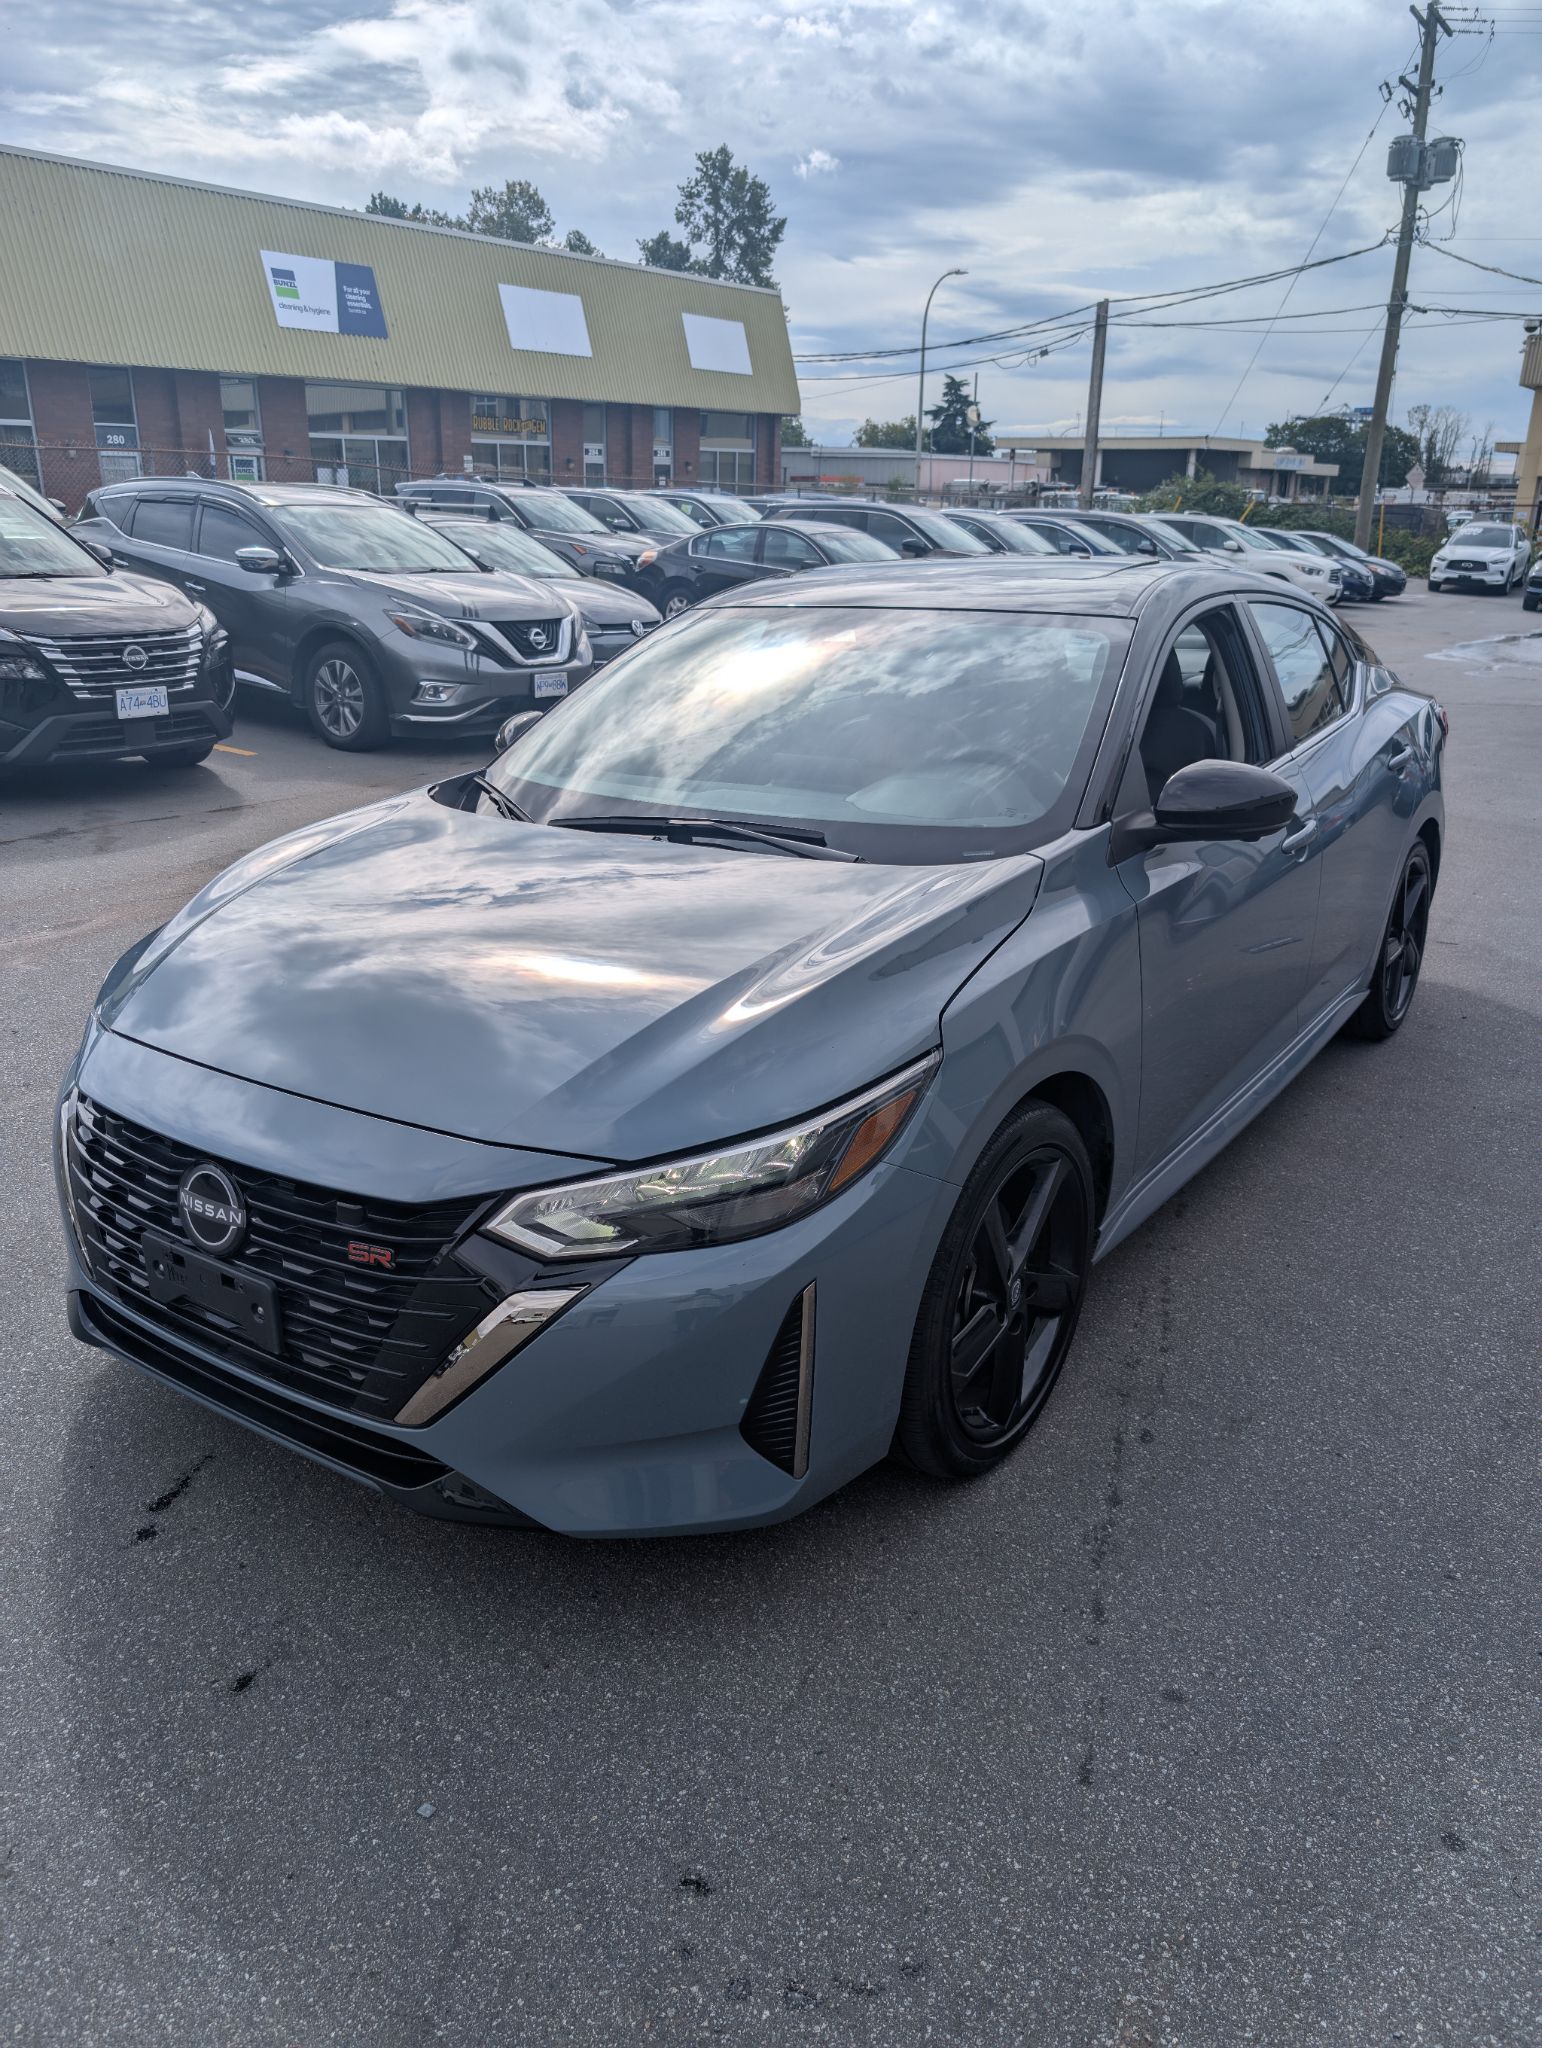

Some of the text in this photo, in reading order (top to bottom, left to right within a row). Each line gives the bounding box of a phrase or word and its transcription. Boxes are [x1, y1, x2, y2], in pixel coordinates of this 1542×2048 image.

[273, 279, 297, 288] BUNZL
[278, 302, 304, 314] cleaning
[308, 305, 331, 316] hygiene
[106, 434, 125, 445] 280
[180, 1191, 242, 1225] NISSAN
[348, 1240, 396, 1270] SR
